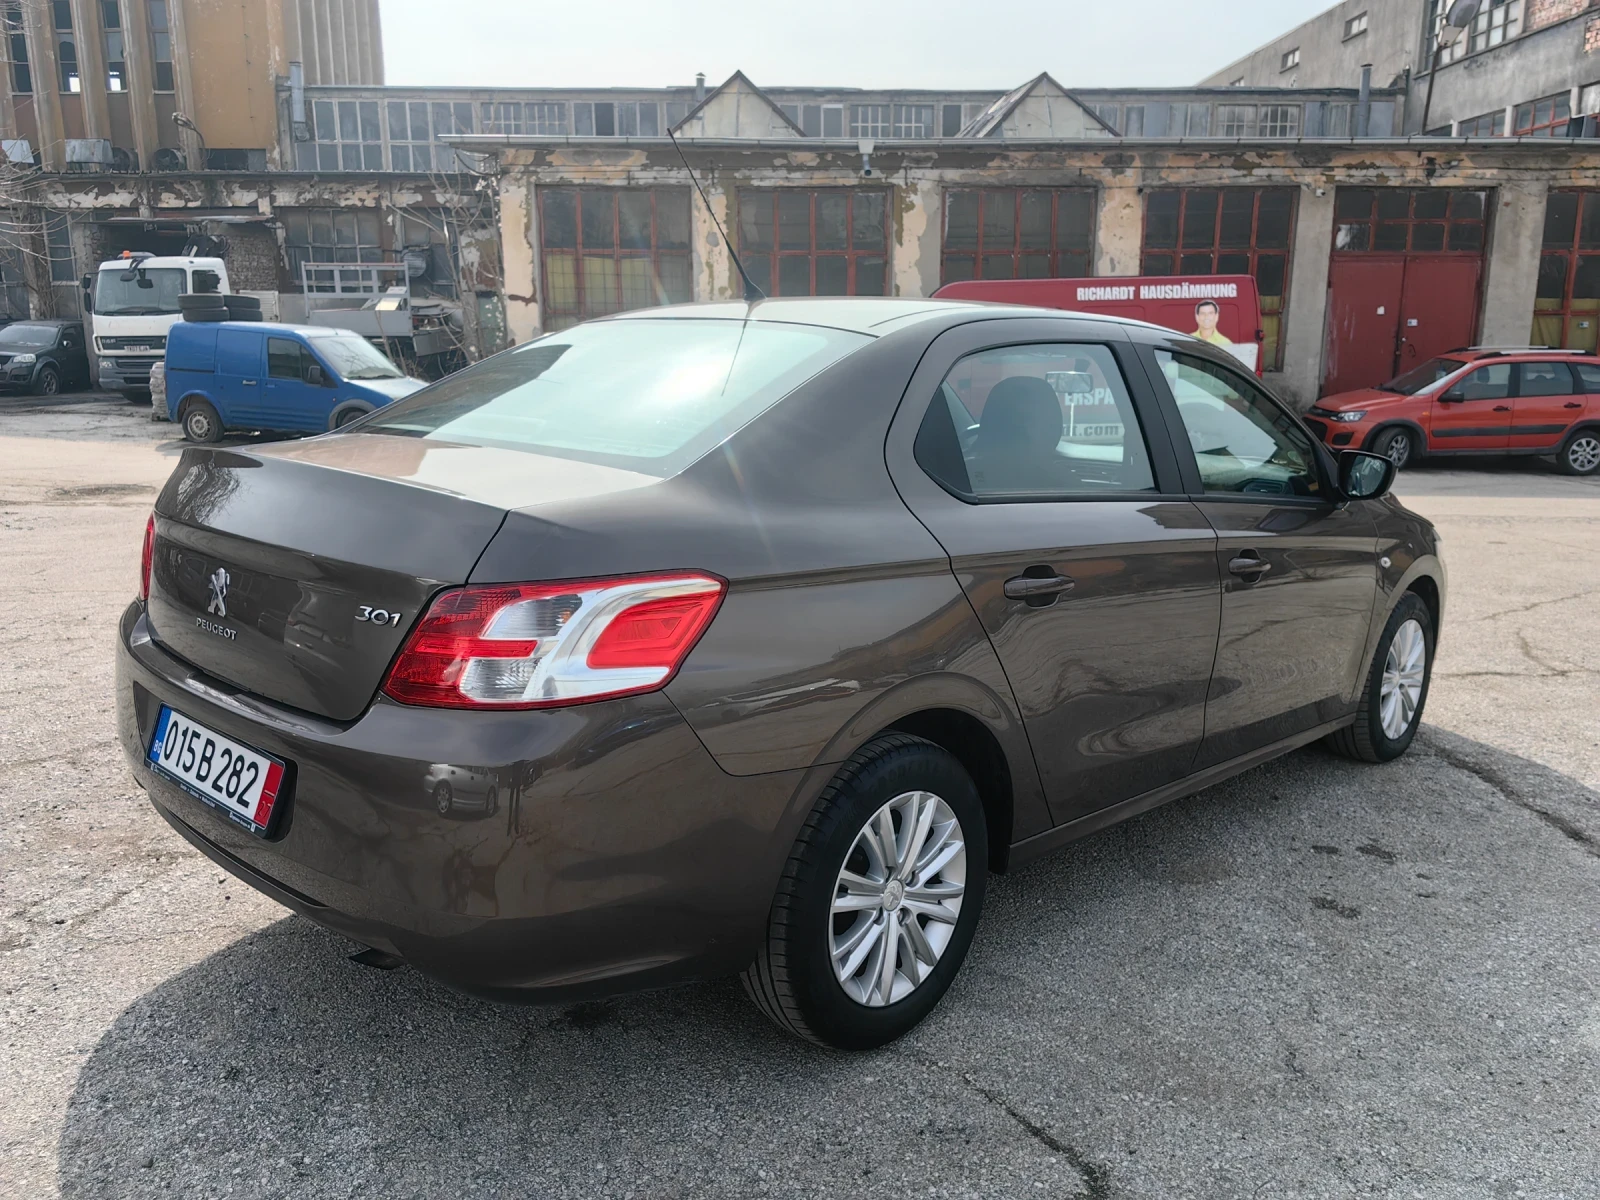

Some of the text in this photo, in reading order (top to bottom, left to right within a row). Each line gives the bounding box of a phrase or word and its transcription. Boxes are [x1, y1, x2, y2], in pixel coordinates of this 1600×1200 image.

[1077, 282, 1237, 300] RICHARDT HAUSDÄMMUNG
[354, 605, 402, 628] 301
[196, 617, 237, 641] PEUGEOT
[153, 740, 163, 754] BG
